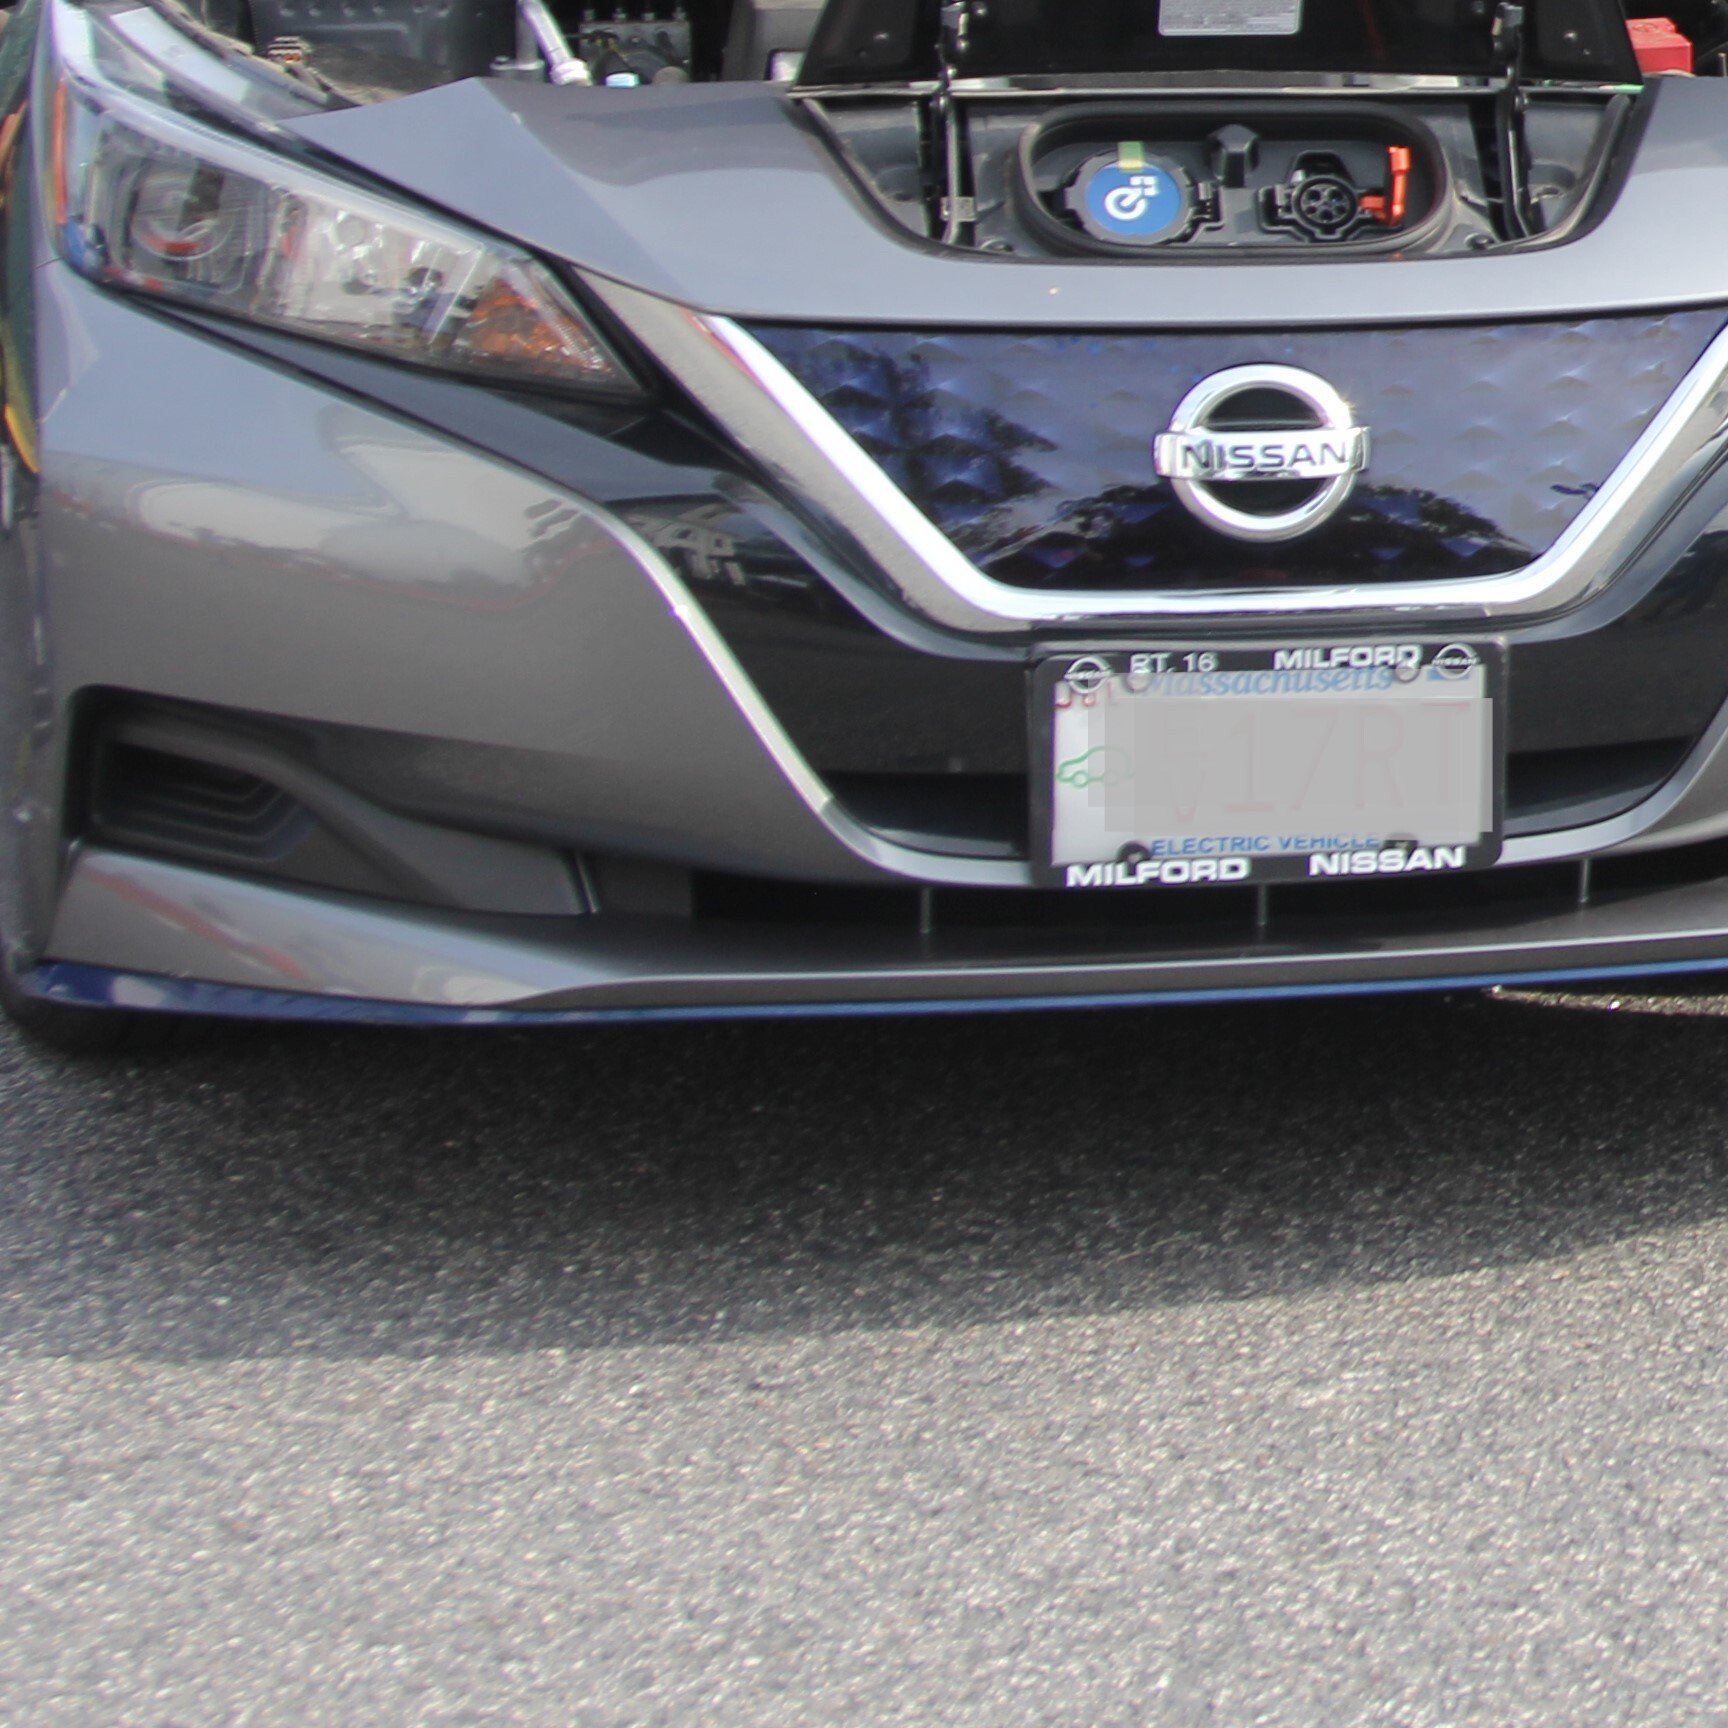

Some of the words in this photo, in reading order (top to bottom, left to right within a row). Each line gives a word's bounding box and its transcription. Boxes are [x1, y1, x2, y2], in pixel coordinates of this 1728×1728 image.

[1182, 439, 1348, 470] NISSAN
[1182, 651, 1220, 673] 16
[1272, 643, 1422, 670] MILFORD
[1150, 835, 1271, 857] ELECTRIC
[1277, 833, 1380, 851] VEHICLE
[1065, 857, 1251, 888] MILFORD
[1308, 845, 1468, 877] NISSAN
